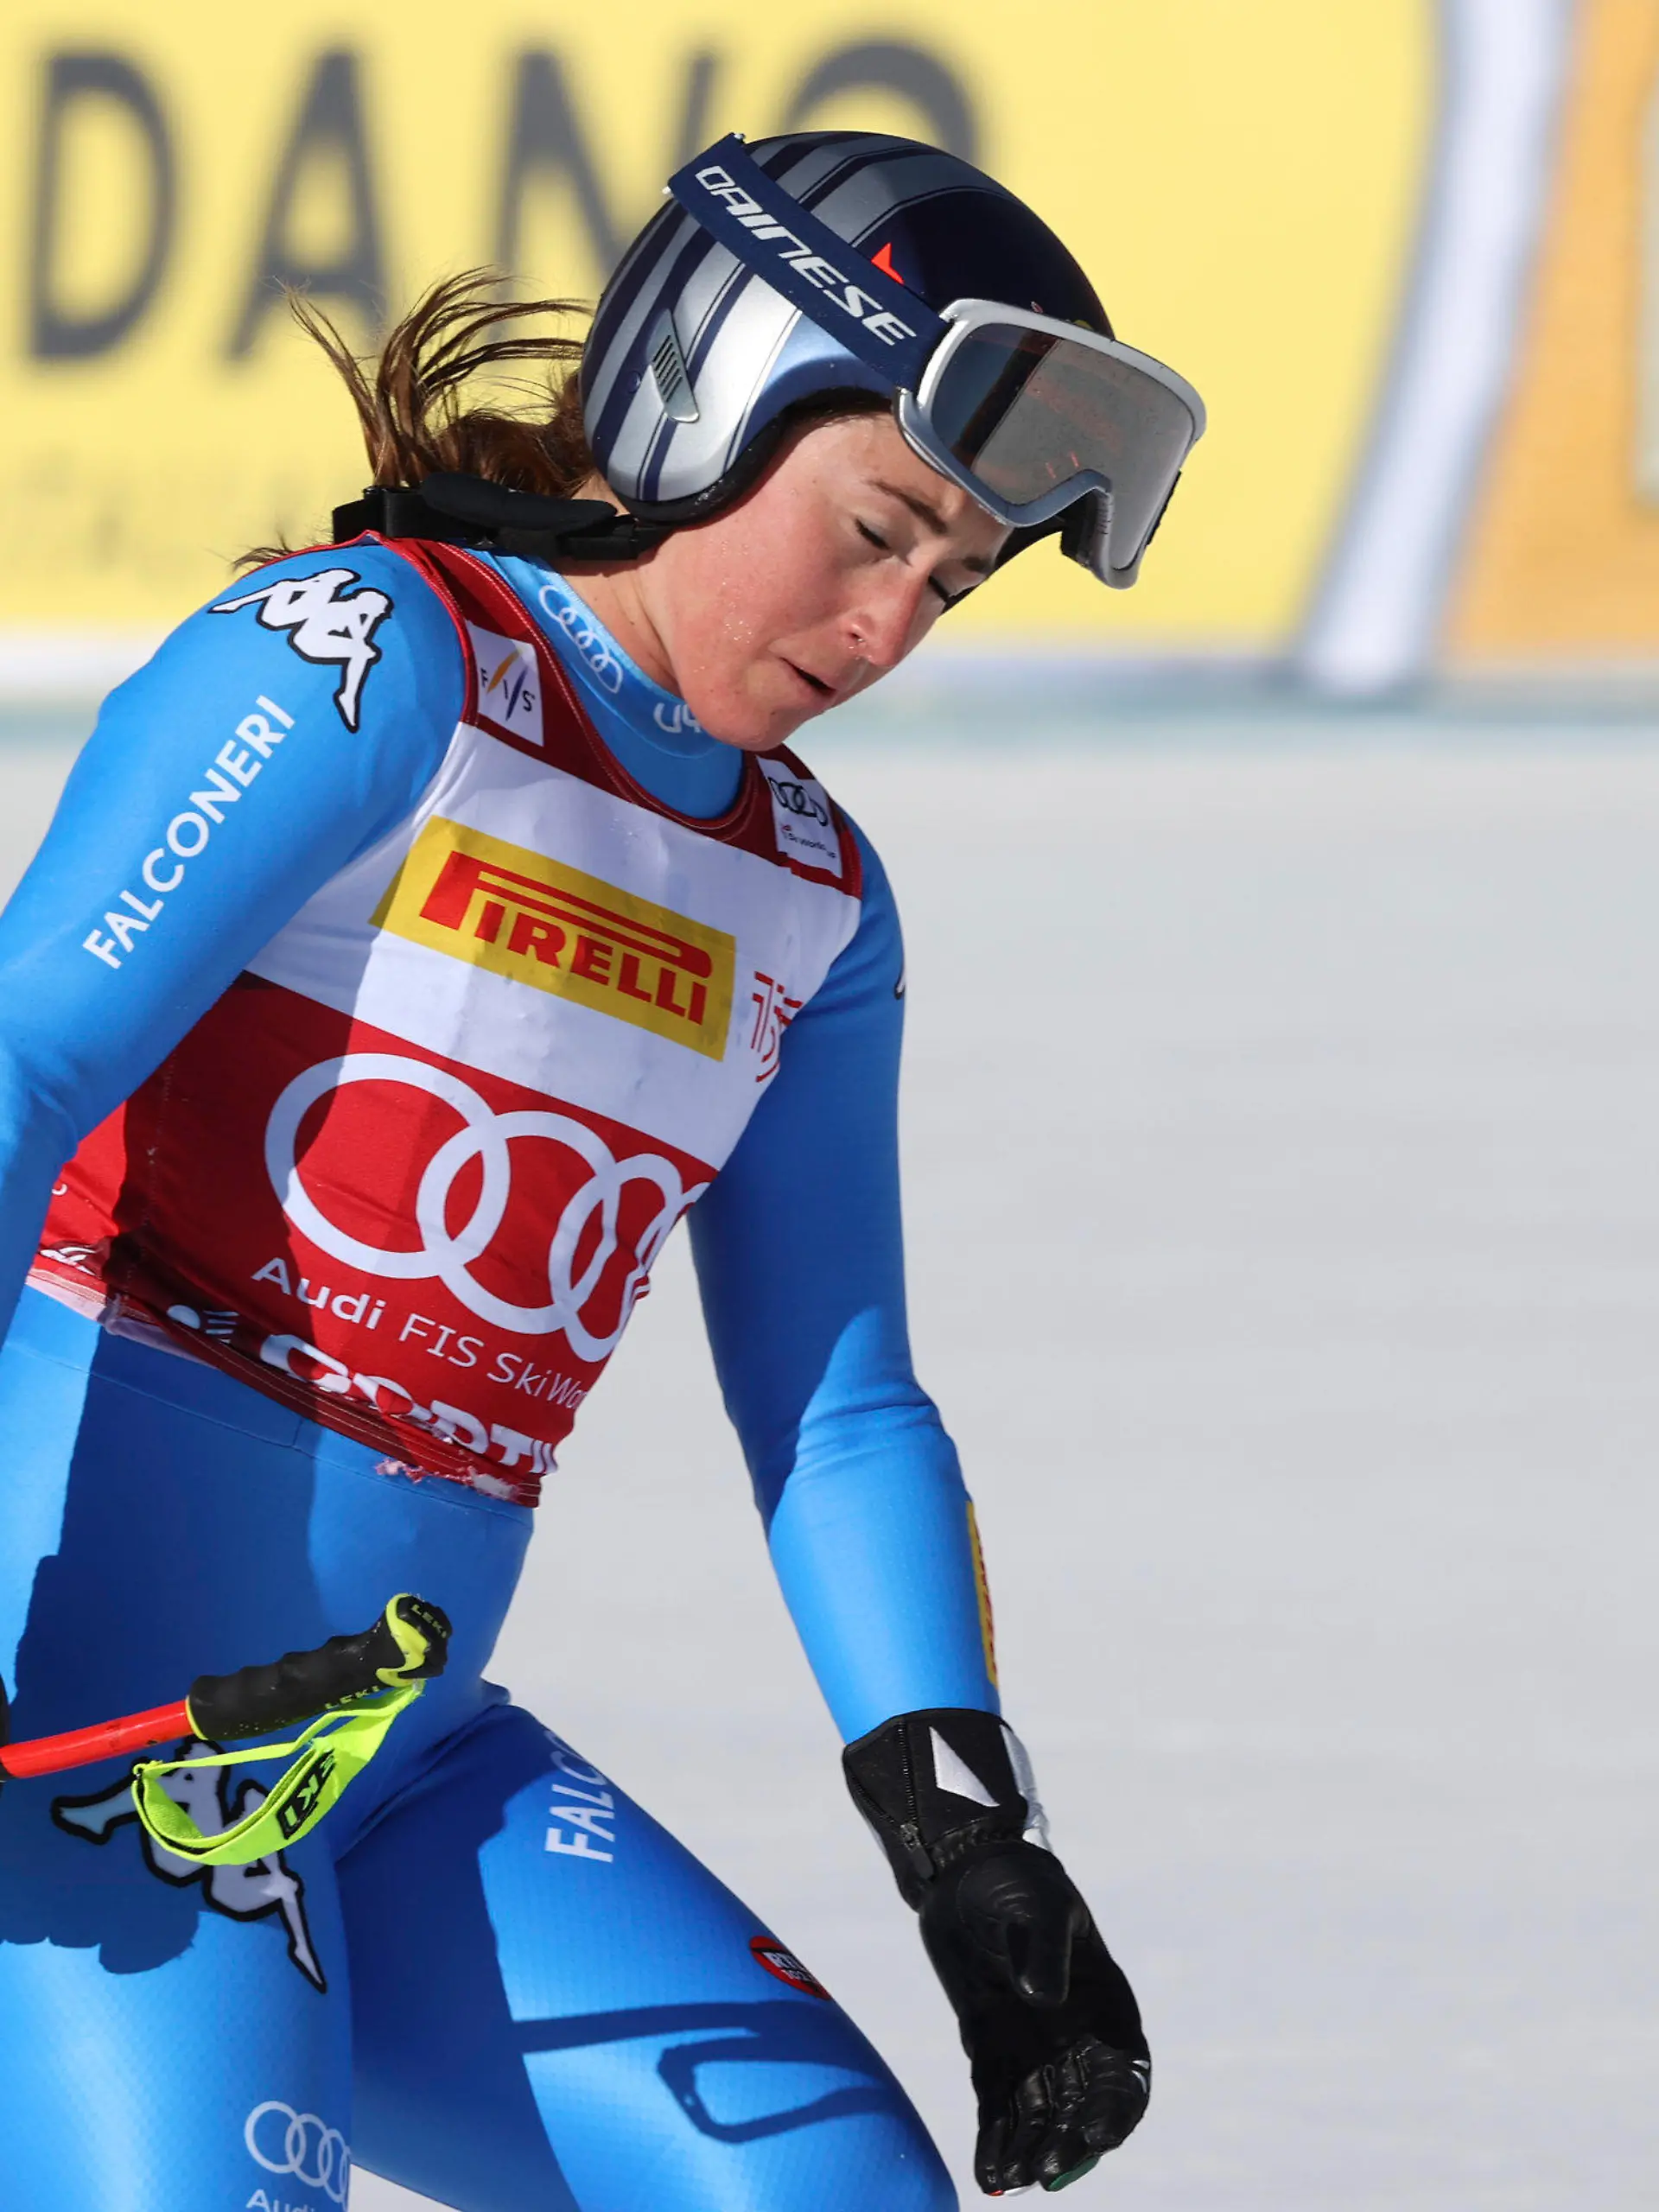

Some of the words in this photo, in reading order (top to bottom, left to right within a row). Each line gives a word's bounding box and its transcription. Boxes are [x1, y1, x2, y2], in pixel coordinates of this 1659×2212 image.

[29, 36, 987, 367] DAN
[695, 165, 916, 346] DAINESE
[480, 665, 536, 714] FIS
[82, 696, 296, 969] FALCONERI
[420, 851, 713, 1026] PIRELLI
[251, 1257, 386, 1330] Audi
[398, 1313, 484, 1368] FIS
[486, 1352, 552, 1398] Ski
[547, 1373, 588, 1408] Wo
[411, 1603, 448, 1638] LEKI
